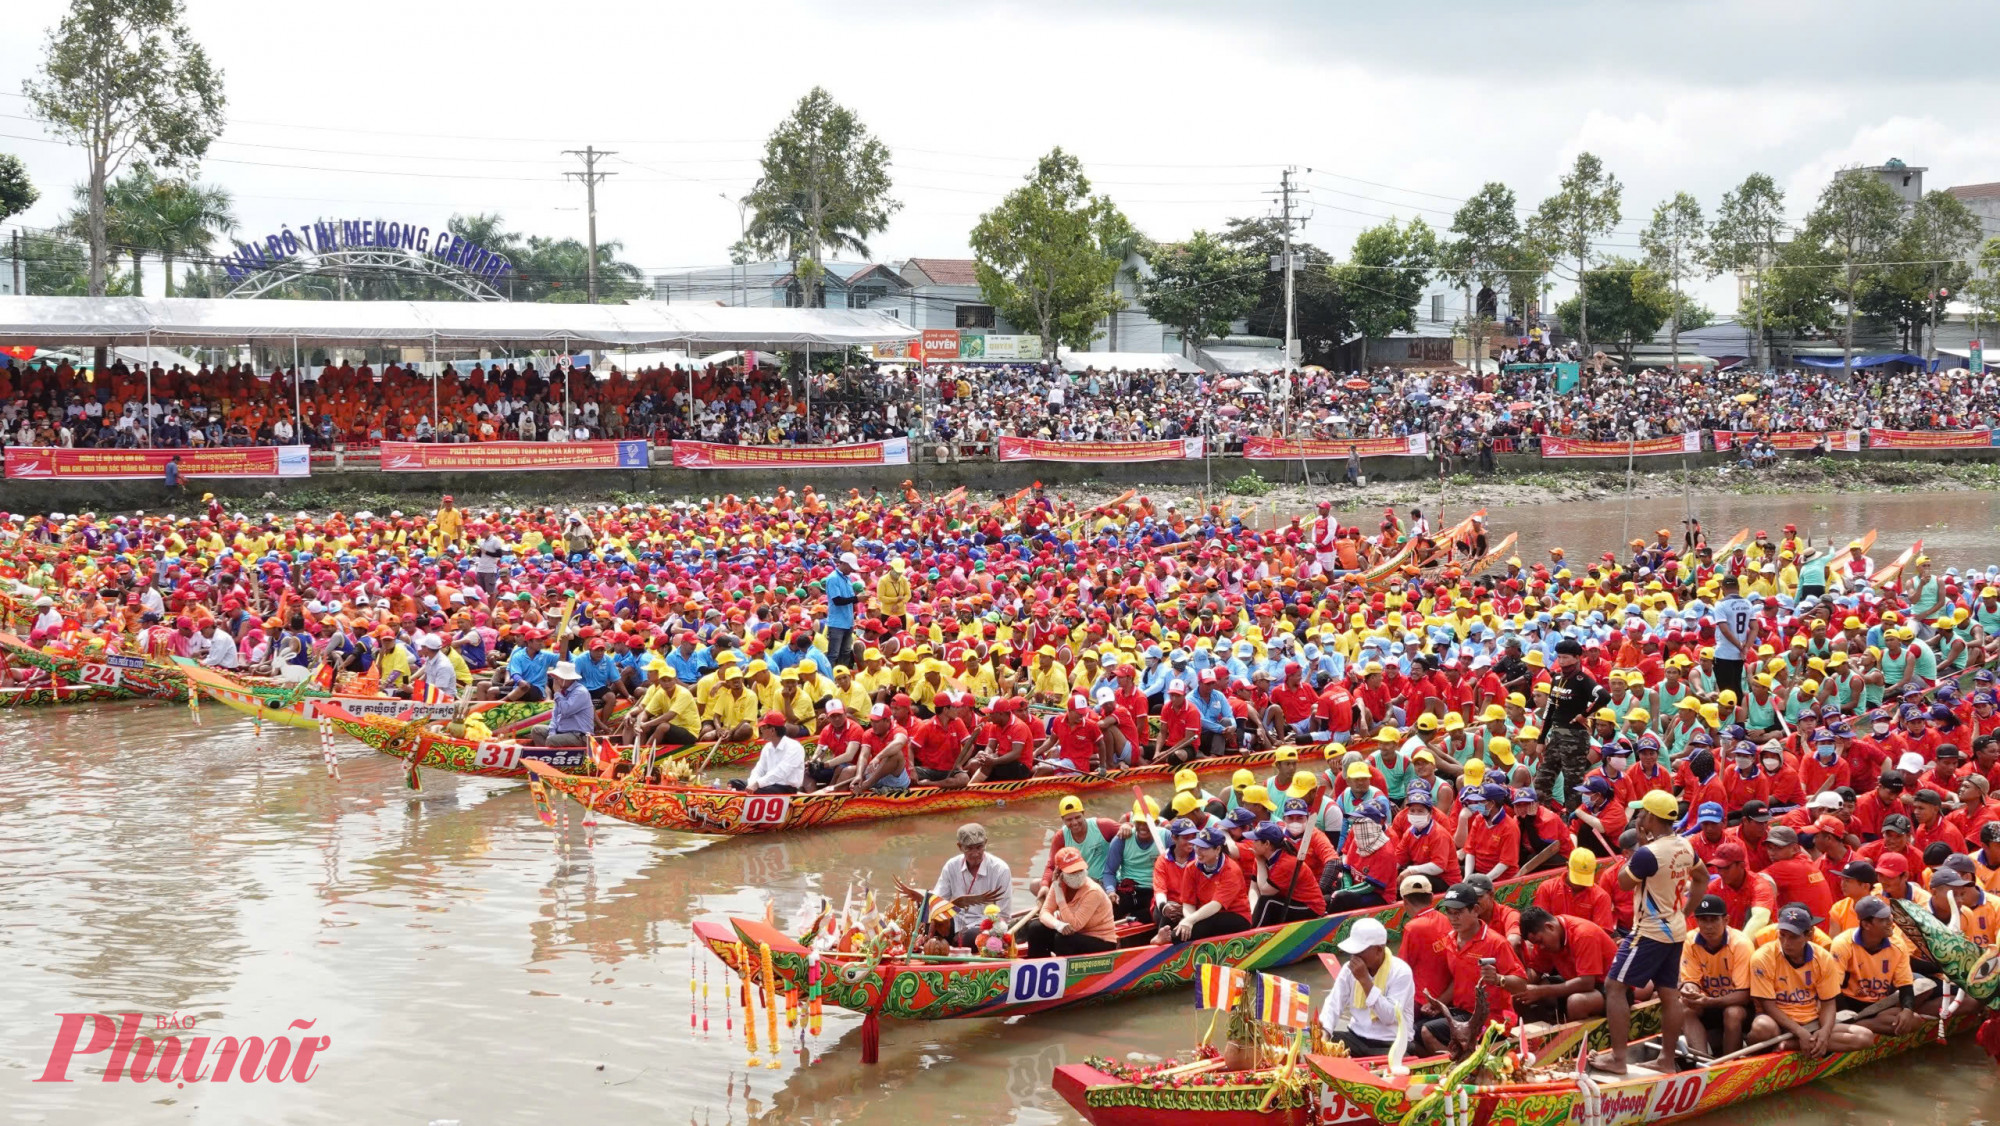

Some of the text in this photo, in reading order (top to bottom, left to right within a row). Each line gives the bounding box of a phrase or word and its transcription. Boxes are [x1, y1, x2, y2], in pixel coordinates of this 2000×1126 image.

[221, 241, 266, 282] KHU
[343, 220, 430, 252] MEKONG
[434, 232, 512, 287] CENTRE
[471, 458, 485, 466] VIỆT
[1736, 612, 1747, 634] 8
[84, 665, 116, 685] 24
[482, 744, 516, 767] 31
[746, 798, 784, 822] 09
[1015, 962, 1060, 1001] 06
[1654, 1076, 1701, 1116] 40
